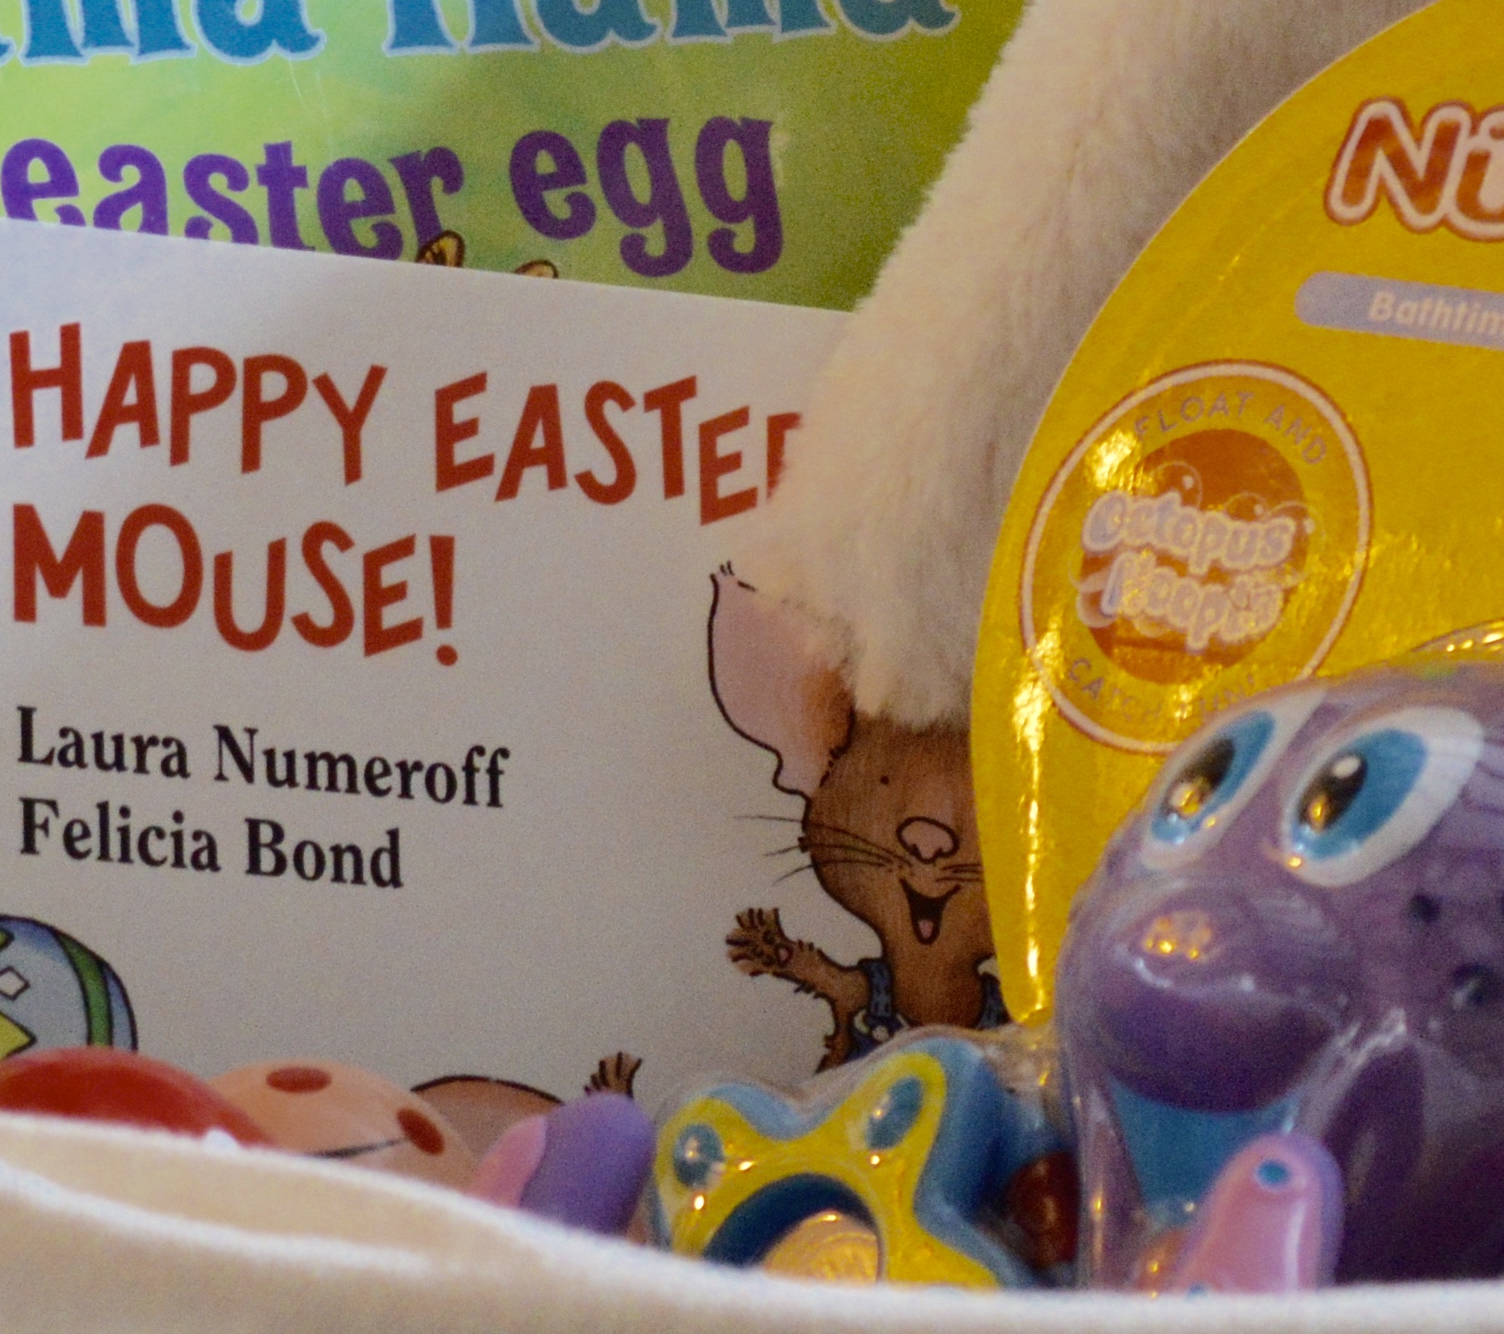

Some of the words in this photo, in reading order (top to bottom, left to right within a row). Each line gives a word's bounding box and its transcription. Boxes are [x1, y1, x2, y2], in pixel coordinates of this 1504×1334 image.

[508, 114, 785, 278] egg
[8, 321, 388, 486] HAPPY
[1132, 390, 1255, 441] FLOAT
[1263, 404, 1329, 465] AND
[11, 501, 457, 667] MOUSE!
[1081, 489, 1297, 576] Octopus
[16, 705, 191, 780] Laura
[213, 724, 511, 809] Numeroff
[19, 797, 221, 873] Felicia
[244, 818, 404, 889] Bond
